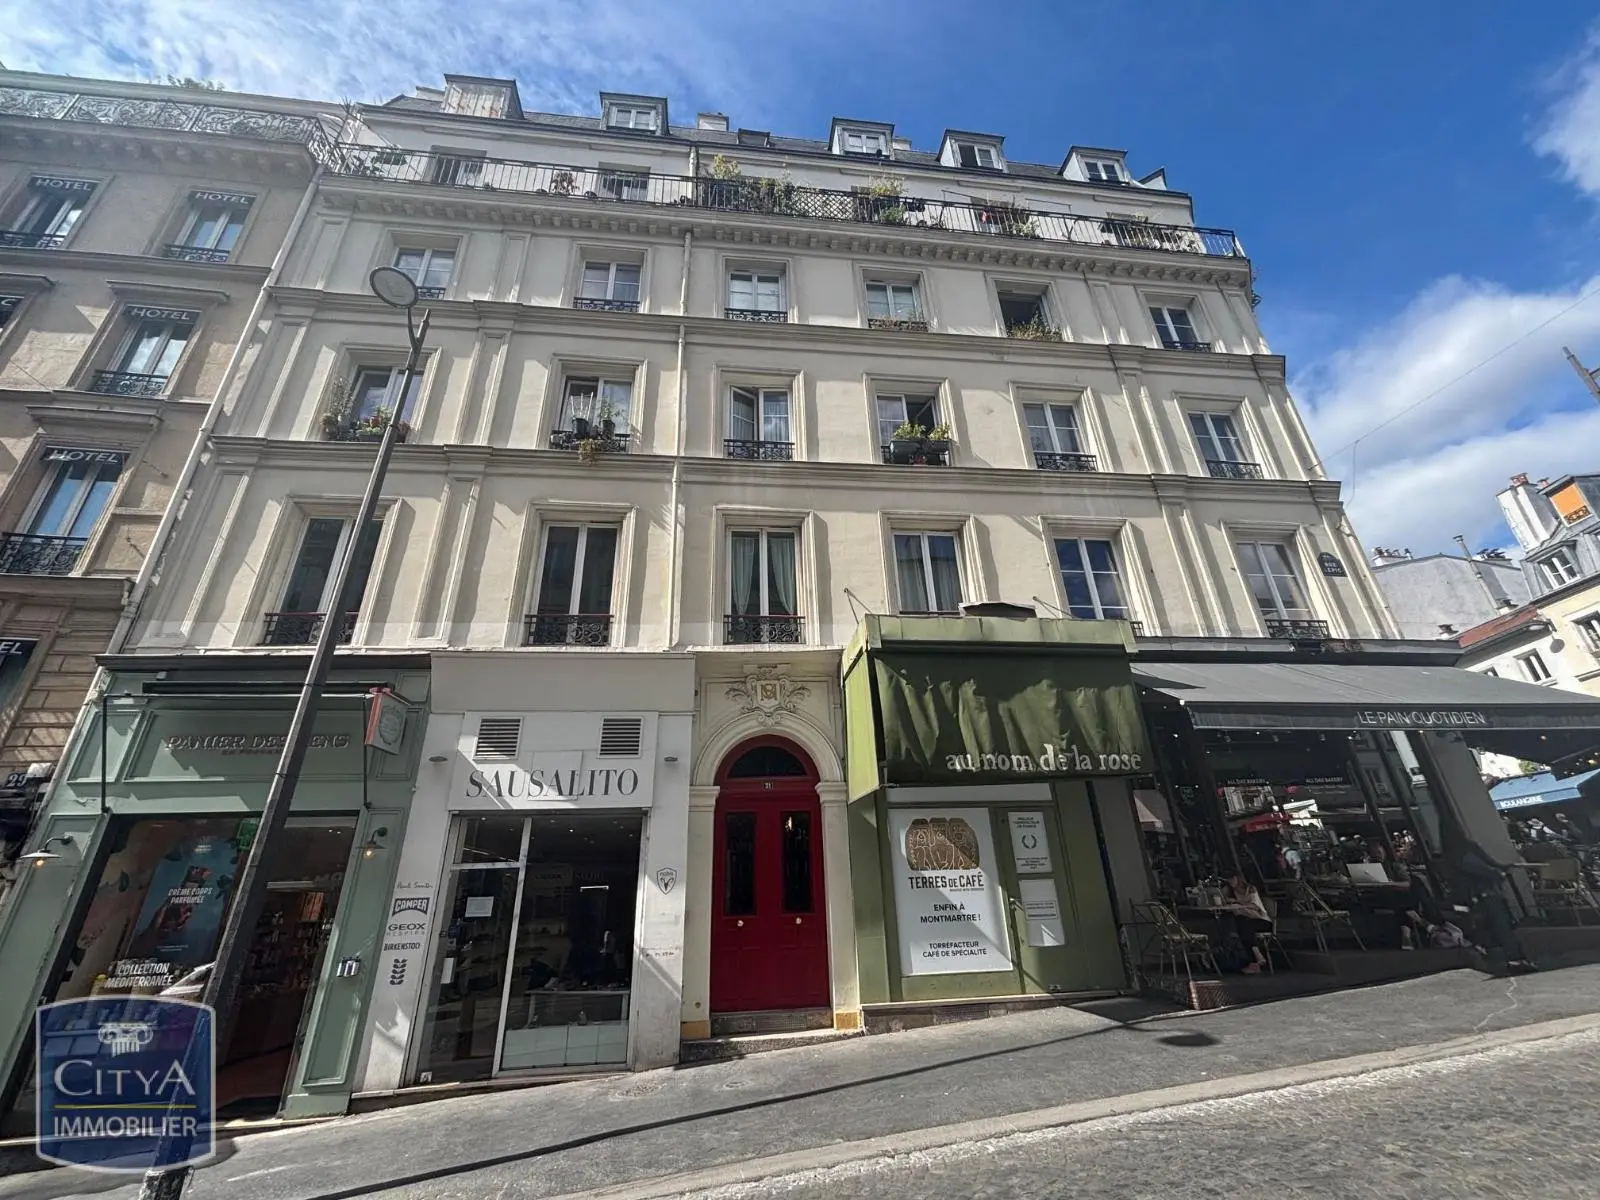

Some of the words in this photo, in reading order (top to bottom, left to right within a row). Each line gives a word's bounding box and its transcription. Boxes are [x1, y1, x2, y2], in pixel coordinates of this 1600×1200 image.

[36, 178, 92, 191] HOTEL
[195, 191, 249, 204] HOTEL
[131, 307, 190, 320] HOTEL
[50, 450, 118, 462] HOTEL
[1357, 711, 1377, 724] LE
[1377, 711, 1411, 724] PAIN
[1411, 711, 1486, 724] QUOTIDIEN
[311, 735, 349, 748] ENS
[945, 752, 977, 772] au
[981, 752, 1033, 772] nom
[1040, 743, 1069, 771] de
[1071, 744, 1092, 771] la
[1099, 752, 1141, 771] rose
[7, 773, 28, 787] 29
[466, 768, 639, 798] SAUSALITO
[908, 875, 948, 889] TERRES
[948, 878, 958, 888] DE
[958, 871, 984, 887] CAFÉ
[395, 899, 428, 912] CAMPER
[933, 903, 958, 911] ENFIN
[920, 913, 978, 923] MONTMARTRE
[388, 922, 427, 932] GEOX
